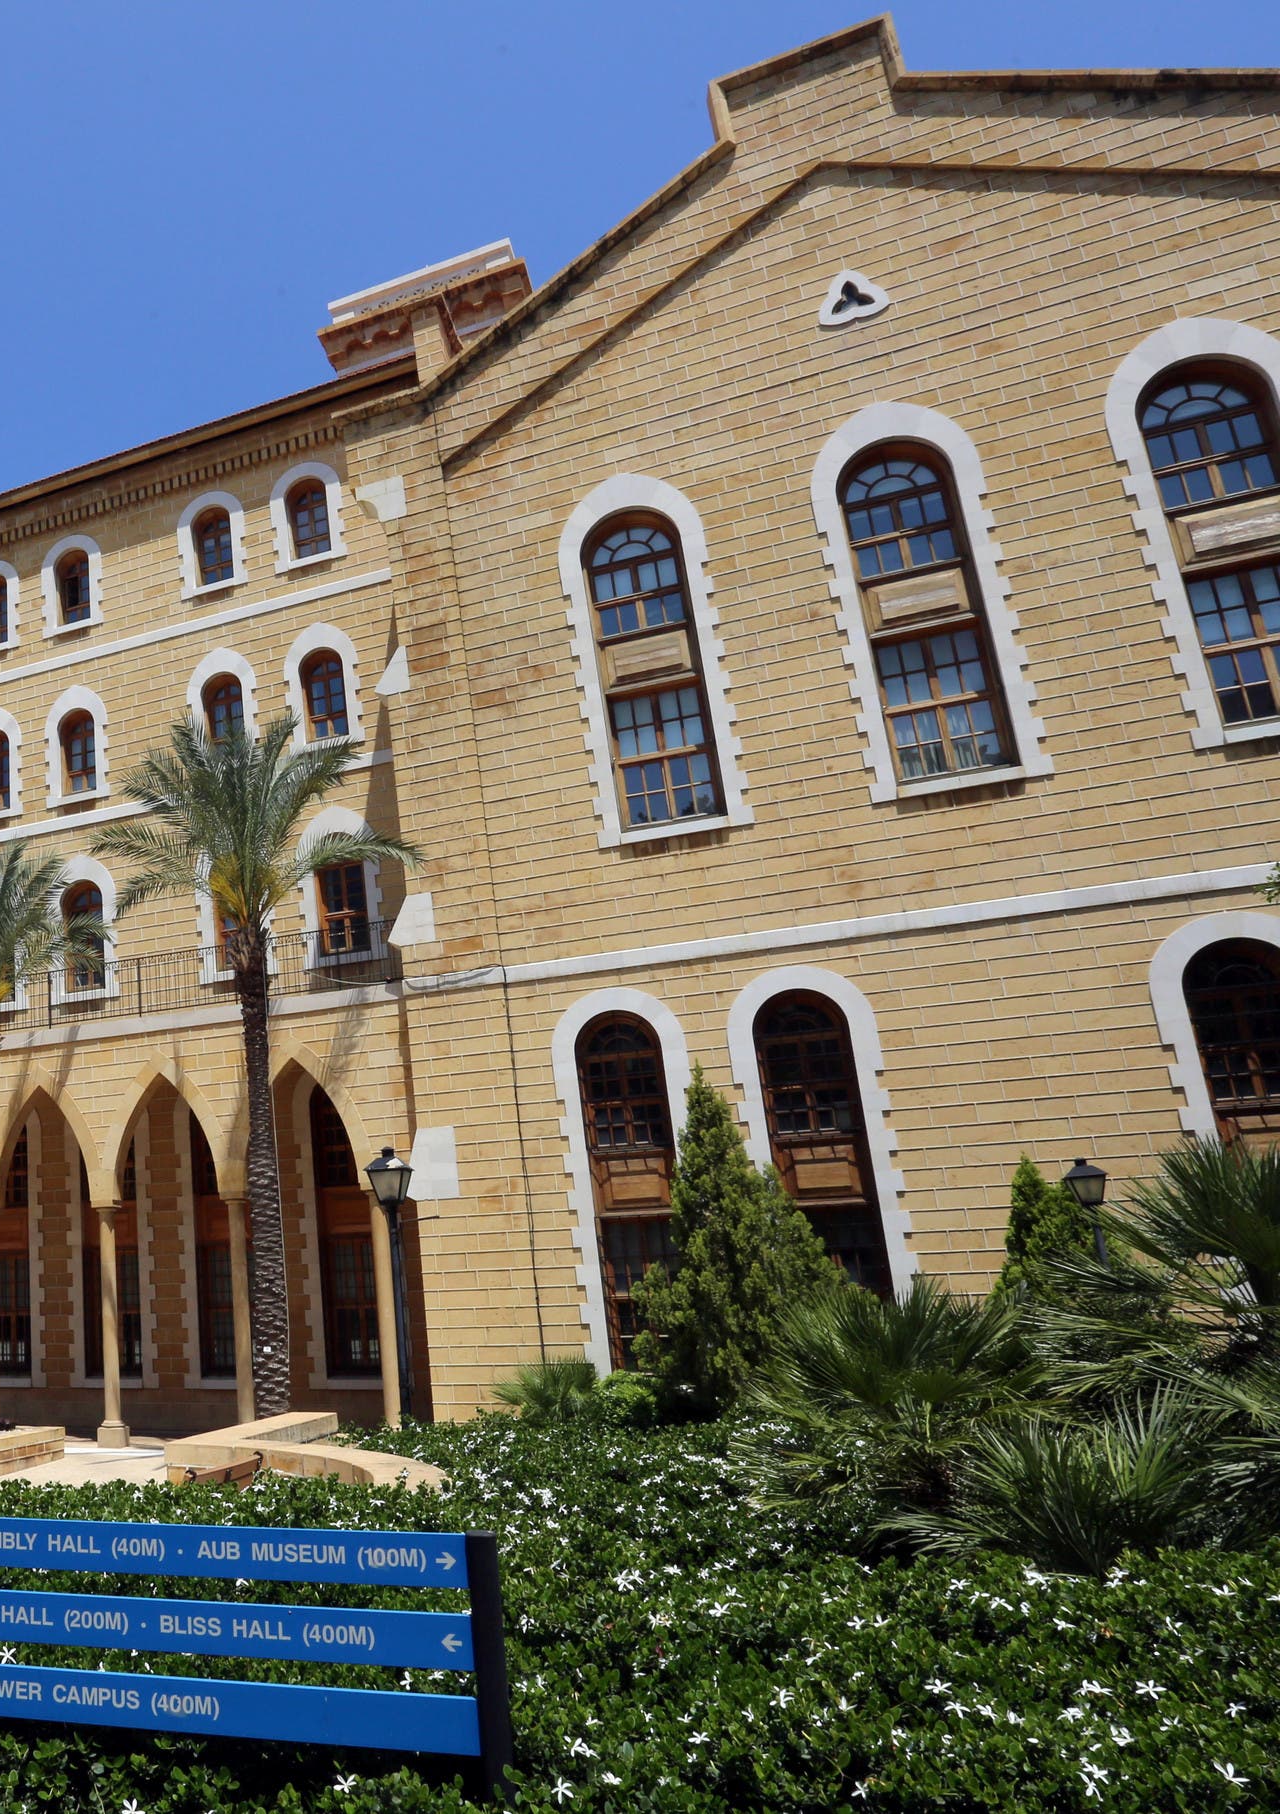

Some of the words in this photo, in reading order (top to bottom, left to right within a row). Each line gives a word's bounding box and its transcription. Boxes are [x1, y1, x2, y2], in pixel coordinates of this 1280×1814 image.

[47, 1534, 101, 1554] HALL
[111, 1536, 166, 1562] (40M)
[197, 1540, 241, 1560] AUB
[251, 1542, 346, 1565] MUSEUM
[357, 1546, 427, 1573] (100M)
[1, 1605, 54, 1626] HALL
[64, 1608, 129, 1635] (200M)
[159, 1614, 222, 1637] BLISS
[232, 1618, 291, 1641] HALL
[302, 1622, 376, 1651] (400M)
[52, 1683, 140, 1710] CAMPUS
[151, 1692, 220, 1721] (400M)
